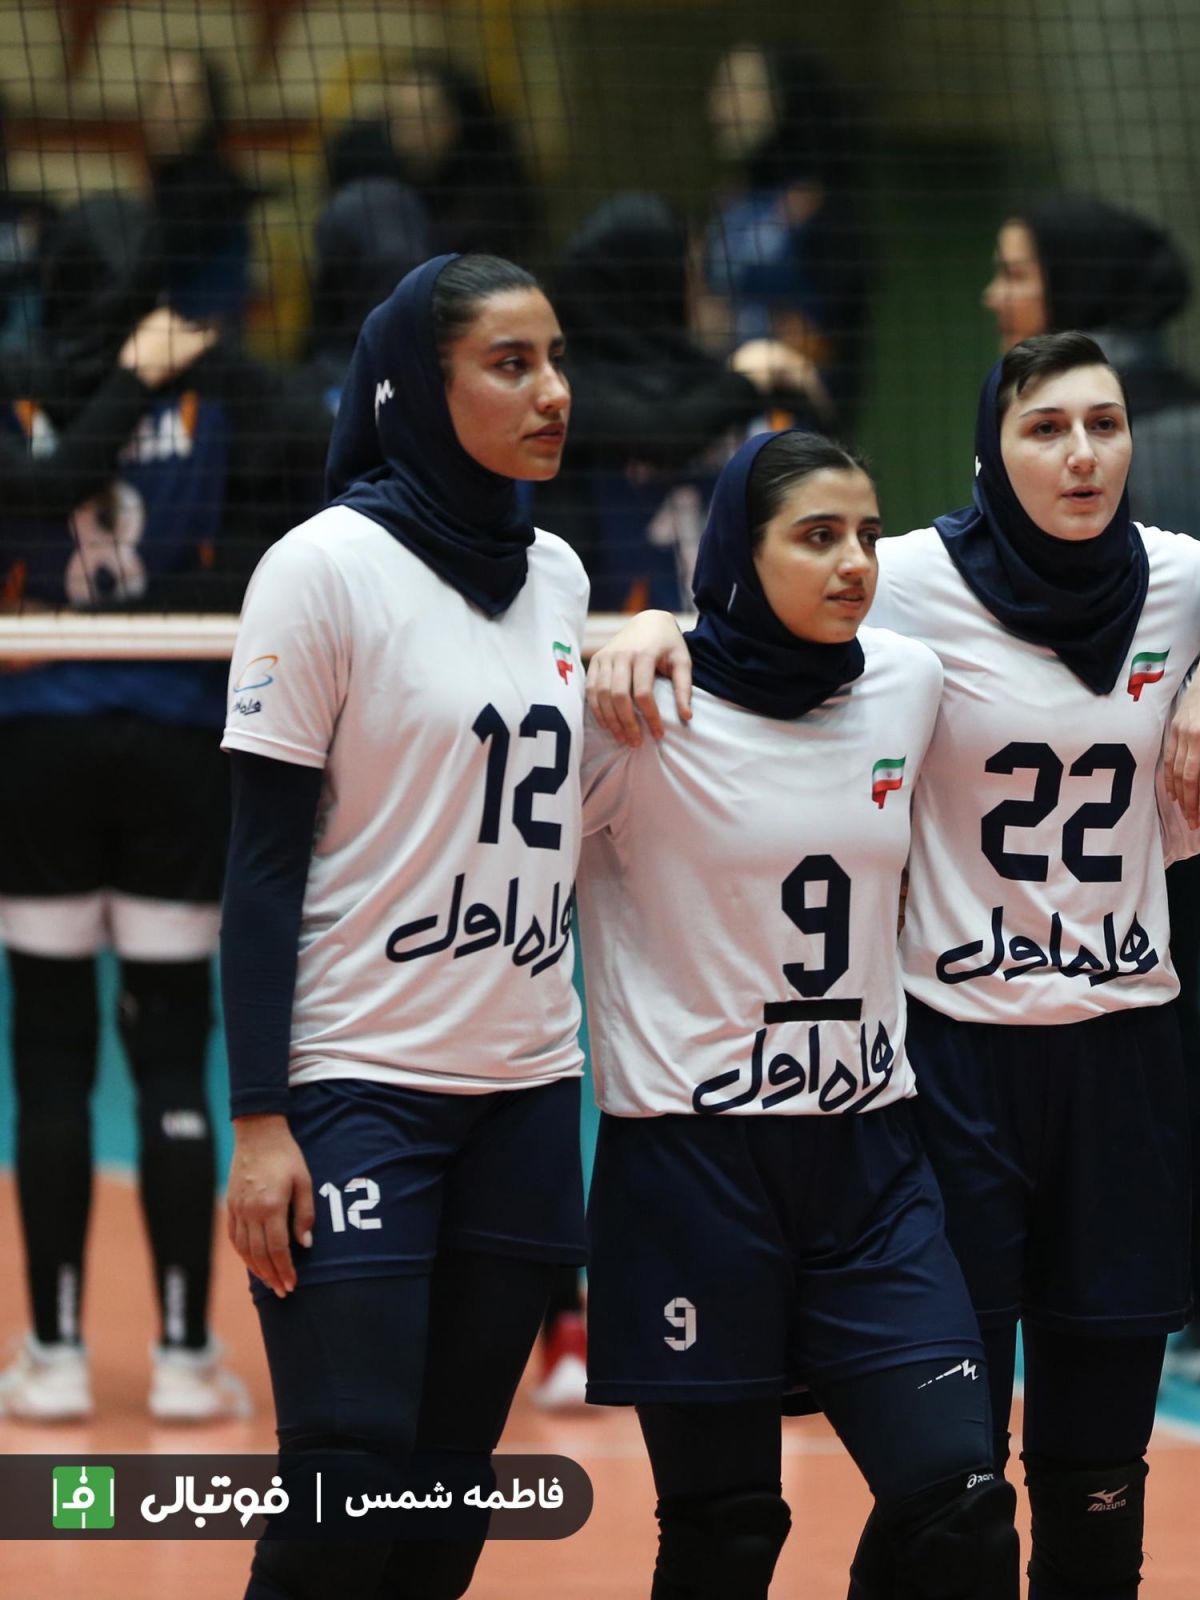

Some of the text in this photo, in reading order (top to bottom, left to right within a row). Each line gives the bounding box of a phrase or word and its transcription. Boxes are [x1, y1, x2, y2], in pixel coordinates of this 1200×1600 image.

[471, 703, 571, 850] 12
[981, 742, 1137, 882] 22
[386, 873, 519, 963] اول
[781, 854, 851, 997] 9
[936, 906, 1063, 985] اول
[692, 1024, 820, 1114] اول
[319, 1178, 382, 1232] 12
[664, 1297, 697, 1351] 9
